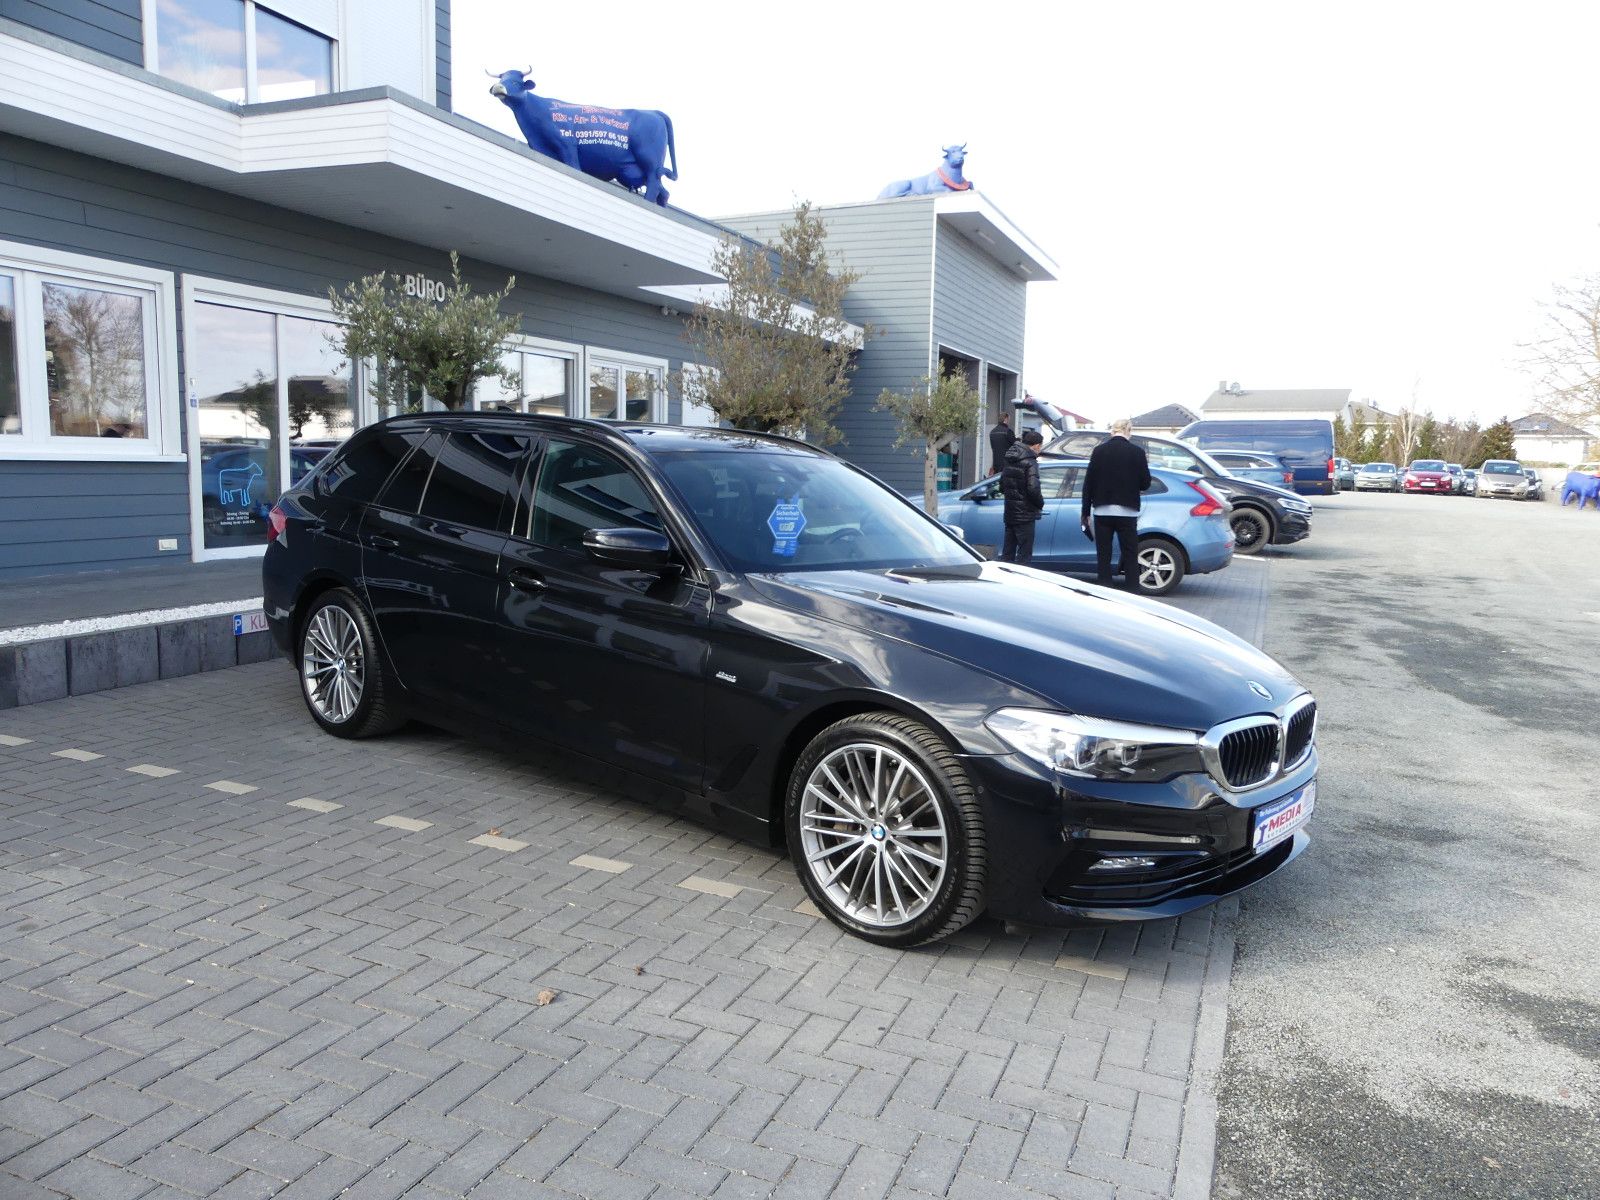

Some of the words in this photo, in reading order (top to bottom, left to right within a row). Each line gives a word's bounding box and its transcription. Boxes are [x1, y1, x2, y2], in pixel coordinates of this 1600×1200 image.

[560, 129, 574, 137] Tel.
[405, 272, 446, 302] BÜRO
[1268, 802, 1302, 832] MEDIA
